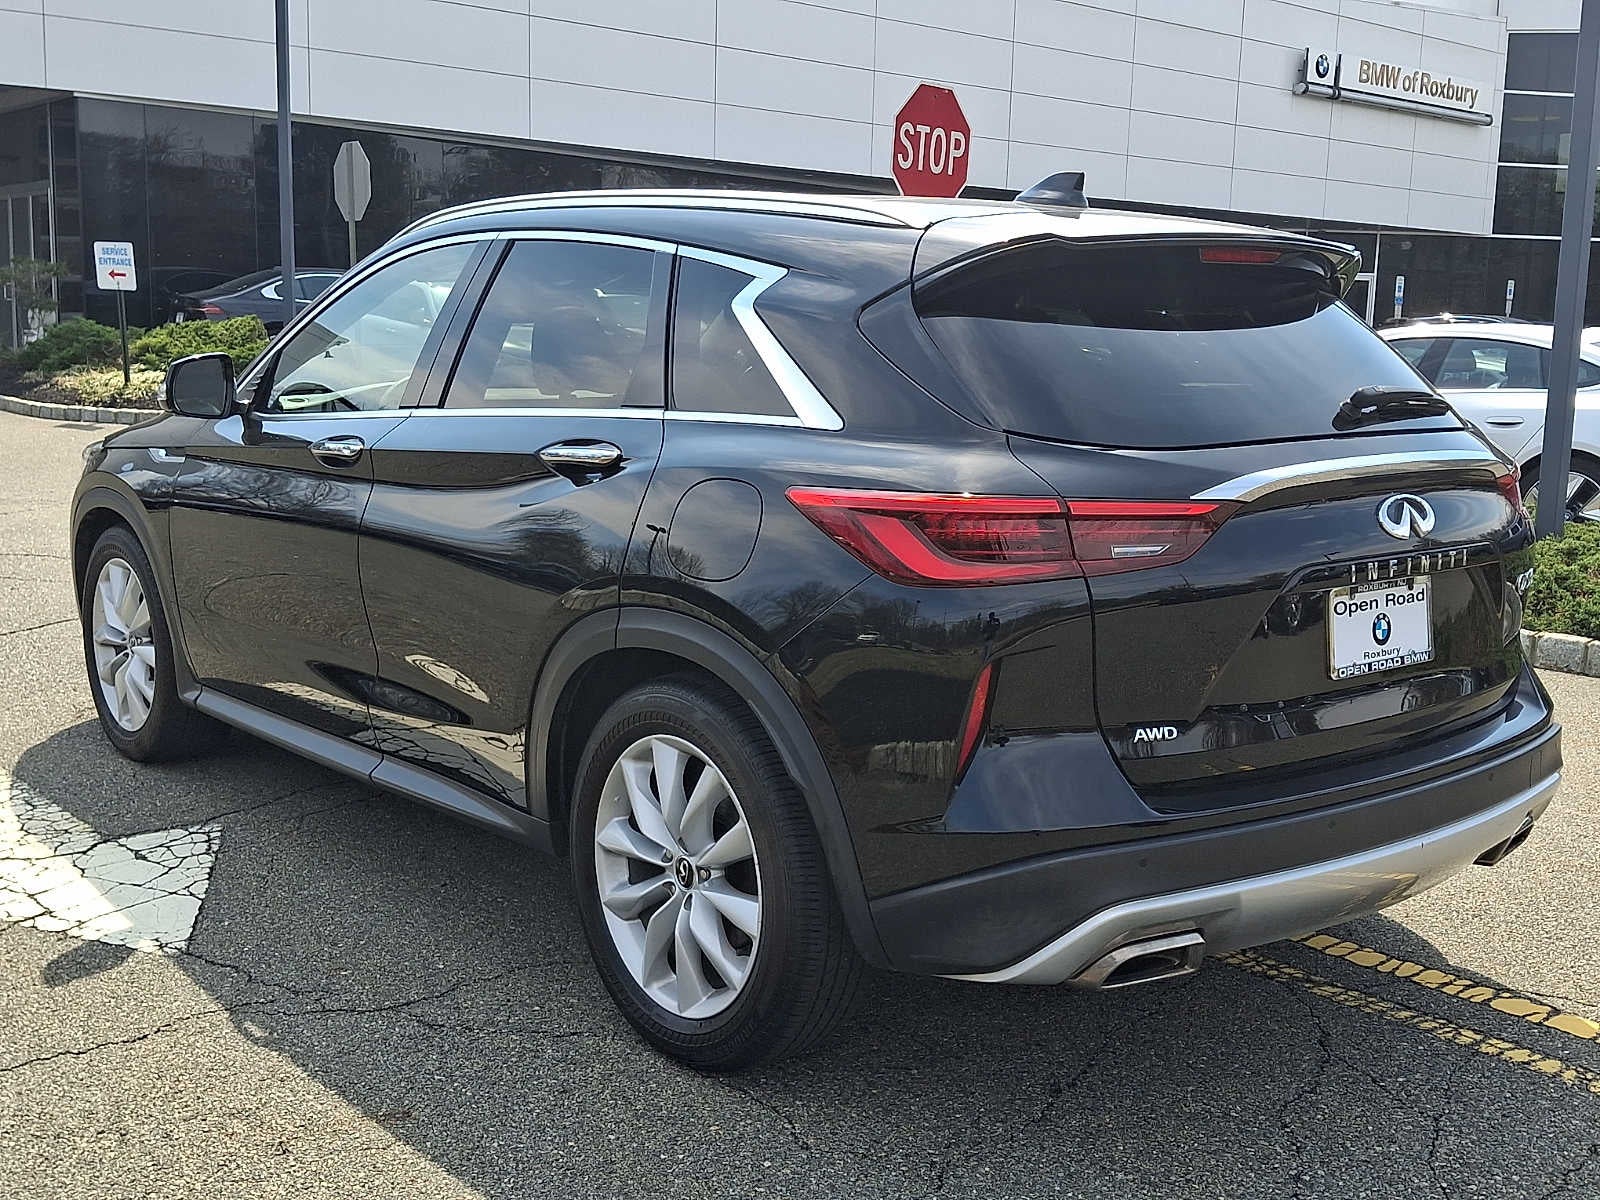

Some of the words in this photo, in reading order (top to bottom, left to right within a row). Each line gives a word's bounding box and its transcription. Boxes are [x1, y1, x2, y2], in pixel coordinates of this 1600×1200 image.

[1359, 59, 1401, 89] BMW
[1402, 71, 1419, 93] of
[1420, 71, 1478, 109] Roxbury
[898, 122, 966, 175] STOP
[99, 257, 132, 266] ENTRANCE
[102, 247, 128, 256] SERVICE
[1351, 549, 1467, 583] INFINITI
[1333, 598, 1379, 617] Open
[1385, 588, 1425, 607] Road
[1339, 664, 1369, 678] OPEN
[1371, 657, 1402, 671] ROAD
[1404, 652, 1430, 665] BMW
[1363, 647, 1401, 660] Roxbury
[1133, 726, 1178, 743] AWD
